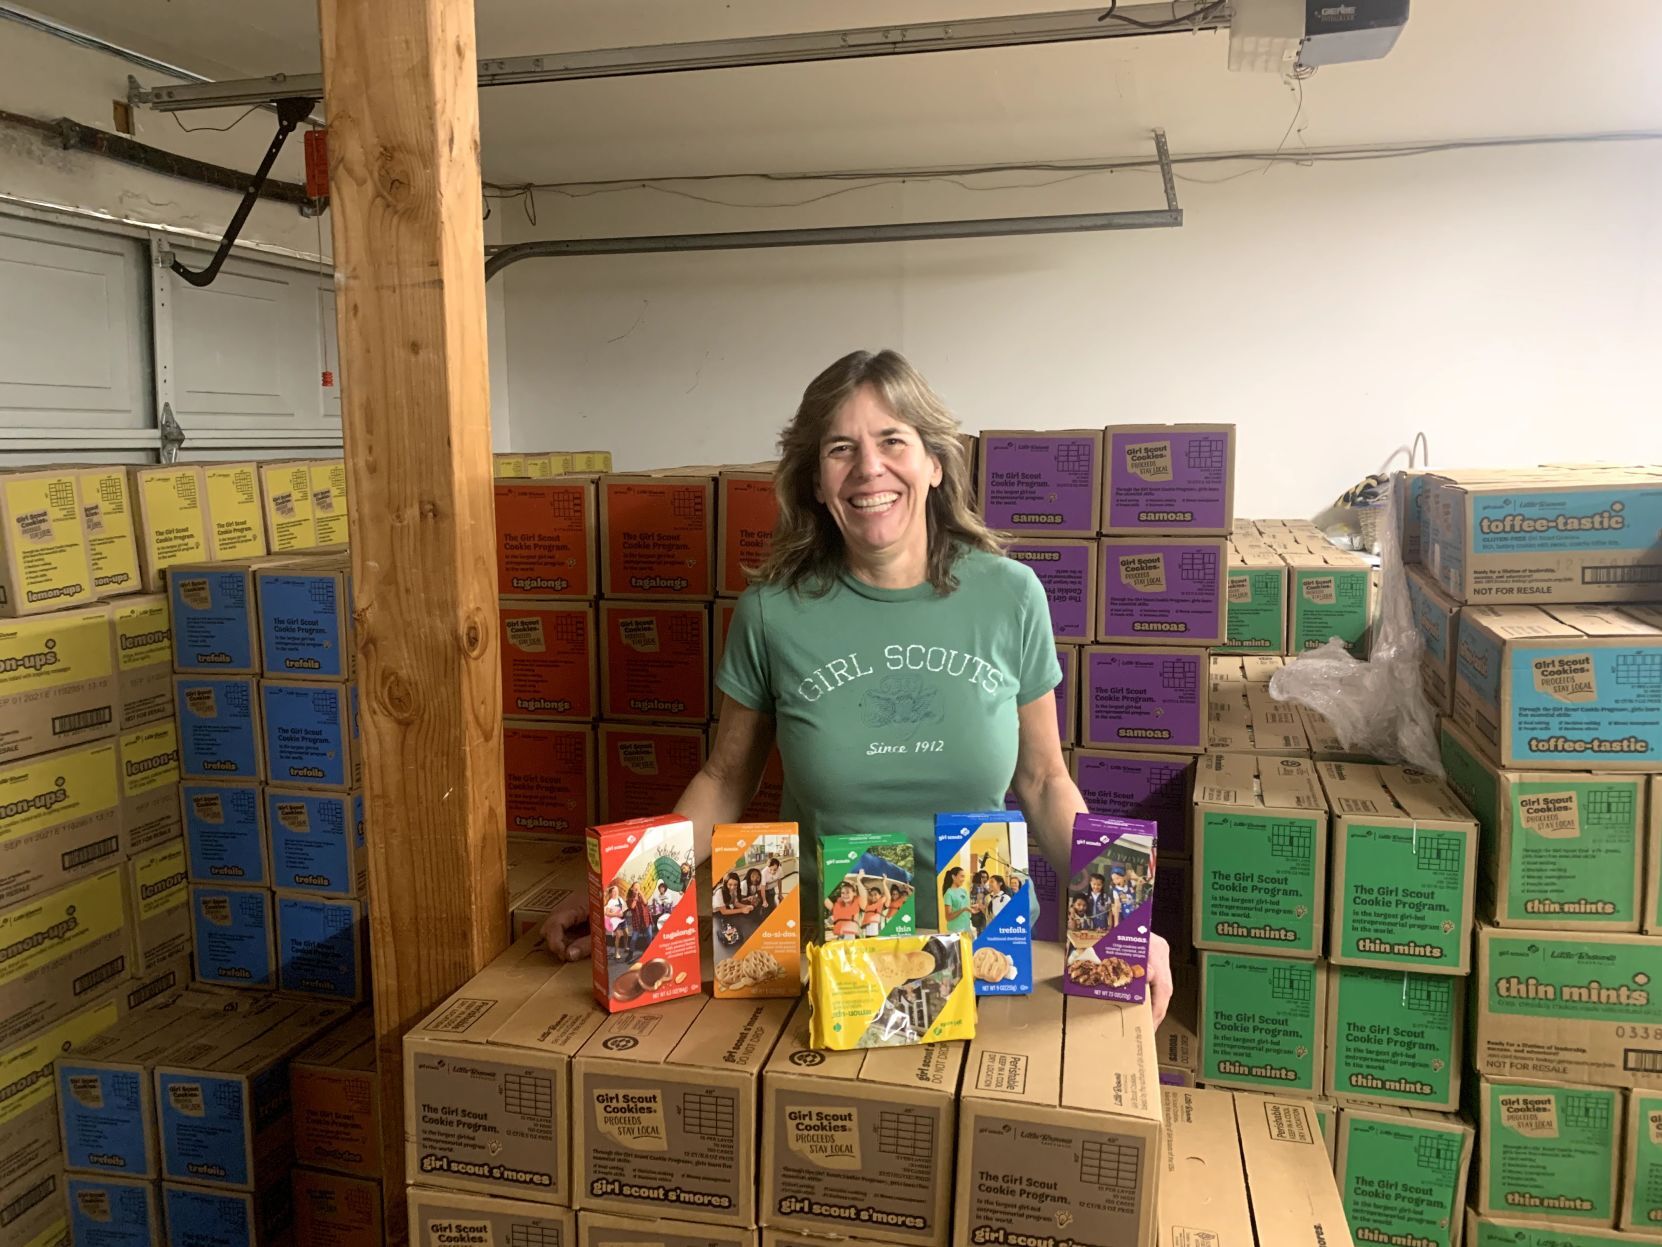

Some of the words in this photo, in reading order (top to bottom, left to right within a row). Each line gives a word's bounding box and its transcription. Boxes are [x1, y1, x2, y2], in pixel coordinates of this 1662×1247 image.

[1127, 447, 1143, 456] Girl
[1144, 445, 1168, 454] Scout
[1006, 472, 1019, 480] Girl
[1012, 513, 1065, 524] samoas
[1138, 511, 1194, 522] samoas
[1480, 511, 1627, 534] toffee-tastic
[504, 533, 518, 541] The
[520, 533, 536, 541] Girl
[537, 534, 560, 542] Scout
[1120, 558, 1136, 567] Girl
[1137, 556, 1161, 566] Scout
[513, 577, 568, 591] tagalongs
[630, 576, 688, 590] tagalongs
[27, 583, 82, 603] lemon-ups
[1474, 587, 1493, 595] NOT
[1495, 587, 1514, 595] FOR
[1517, 586, 1552, 595] RESALE
[506, 620, 519, 629] Girl
[520, 619, 539, 627] Scout
[1133, 621, 1187, 632] samoas
[120, 629, 171, 650] lemon-
[0, 651, 57, 674] on-ups
[198, 653, 231, 664] trefoils
[285, 658, 320, 669] trefoils
[1535, 660, 1556, 670] Girl
[1558, 657, 1590, 667] Scout
[798, 653, 873, 701] GIRL
[884, 645, 1003, 695] SCOUTS
[1110, 687, 1125, 695] Girl
[1126, 687, 1147, 695] Scout
[517, 699, 570, 712] tagalongs
[630, 699, 684, 712] tagalongs
[1117, 727, 1171, 739] samoas
[866, 742, 908, 756] Since
[915, 740, 945, 753] 1912
[1529, 736, 1648, 753] toffee-tastic
[126, 750, 178, 777] lemon-
[203, 760, 238, 771] trefoils
[289, 766, 324, 778] trefoils
[0, 788, 66, 819] on-ups
[1521, 798, 1540, 808] Girl
[1543, 796, 1573, 806] Scout
[515, 816, 568, 829] tagalongs
[210, 866, 244, 877] trefoils
[1211, 871, 1231, 881] The
[1234, 872, 1254, 883] Girl
[1257, 874, 1288, 885] Scout
[140, 871, 188, 900] lemon-
[295, 874, 330, 886] trefoils
[1211, 881, 1249, 893] Cookie
[1354, 885, 1374, 895] The
[1377, 886, 1398, 897] Girl
[1402, 888, 1434, 899] Scout
[1353, 896, 1392, 908] Cookie
[1525, 900, 1560, 914] thin
[1563, 900, 1616, 915] mints
[663, 928, 695, 940] tagalongs
[895, 925, 912, 933] thin
[1216, 923, 1247, 937] thin
[1250, 925, 1297, 941] mints
[1117, 935, 1147, 943] samoas
[1357, 938, 1390, 953] thin
[1394, 942, 1443, 958] mints
[1497, 976, 1555, 1000] thin
[1561, 981, 1648, 1006] mints
[1214, 1011, 1233, 1021] The
[1236, 1013, 1255, 1024] Girl
[1258, 1015, 1288, 1026] Scout
[1214, 1021, 1250, 1032] Cookie
[1346, 1022, 1366, 1033] The
[1369, 1024, 1390, 1035] Girl
[1393, 1027, 1424, 1039] Scout
[1346, 1033, 1384, 1044] Cookie
[936, 1062, 946, 1072] NOT
[1006, 1056, 1021, 1090] Perishable
[1218, 1061, 1250, 1076] thin
[1252, 1063, 1297, 1080] mints
[1486, 1060, 1506, 1069] NOT
[1510, 1061, 1529, 1070] FOR
[1533, 1064, 1568, 1074] RESALE
[931, 1074, 942, 1084] DO
[1350, 1074, 1382, 1088] thin
[1386, 1077, 1433, 1095] mints
[596, 1094, 619, 1103] Girl
[623, 1095, 657, 1104] Scout
[1522, 1098, 1551, 1106] Scout
[422, 1105, 438, 1114] The
[441, 1107, 458, 1117] Girl
[462, 1110, 488, 1121] Scout
[788, 1112, 812, 1121] Girl
[816, 1112, 852, 1122] Scout
[422, 1116, 454, 1128] Cookie
[604, 1116, 641, 1125] PROCEEDS
[1272, 1104, 1287, 1139] Perishable
[618, 1126, 635, 1136] STAY
[638, 1126, 660, 1135] LOCAL
[796, 1134, 835, 1143] PROCEEDS
[810, 1144, 827, 1153] STAY
[831, 1144, 853, 1153] LOCAL
[89, 1154, 126, 1168] trefoils
[187, 1163, 226, 1177] trefoils
[421, 1156, 448, 1172] girl
[450, 1162, 490, 1178] scout
[492, 1166, 551, 1187] s'mores
[979, 1171, 999, 1182] The
[1002, 1174, 1022, 1185] Girl
[1026, 1178, 1057, 1190] Scout
[1355, 1177, 1374, 1187] The
[1378, 1179, 1399, 1190] Girl
[1401, 1183, 1433, 1196] Scout
[592, 1179, 619, 1195] girl
[622, 1185, 665, 1200] scout
[668, 1188, 730, 1208] s'mores
[978, 1183, 1016, 1197] Cookie
[1354, 1187, 1391, 1200] Cookie
[1505, 1192, 1540, 1206] thin
[1543, 1196, 1594, 1210] mints
[780, 1197, 809, 1213] girl
[812, 1204, 857, 1219] scout
[860, 1208, 925, 1228] s'mores
[432, 1224, 452, 1234] Girl
[455, 1225, 488, 1235] Scout
[974, 1226, 1004, 1245] girl
[1357, 1227, 1387, 1244] thin
[1391, 1233, 1437, 1247] mints
